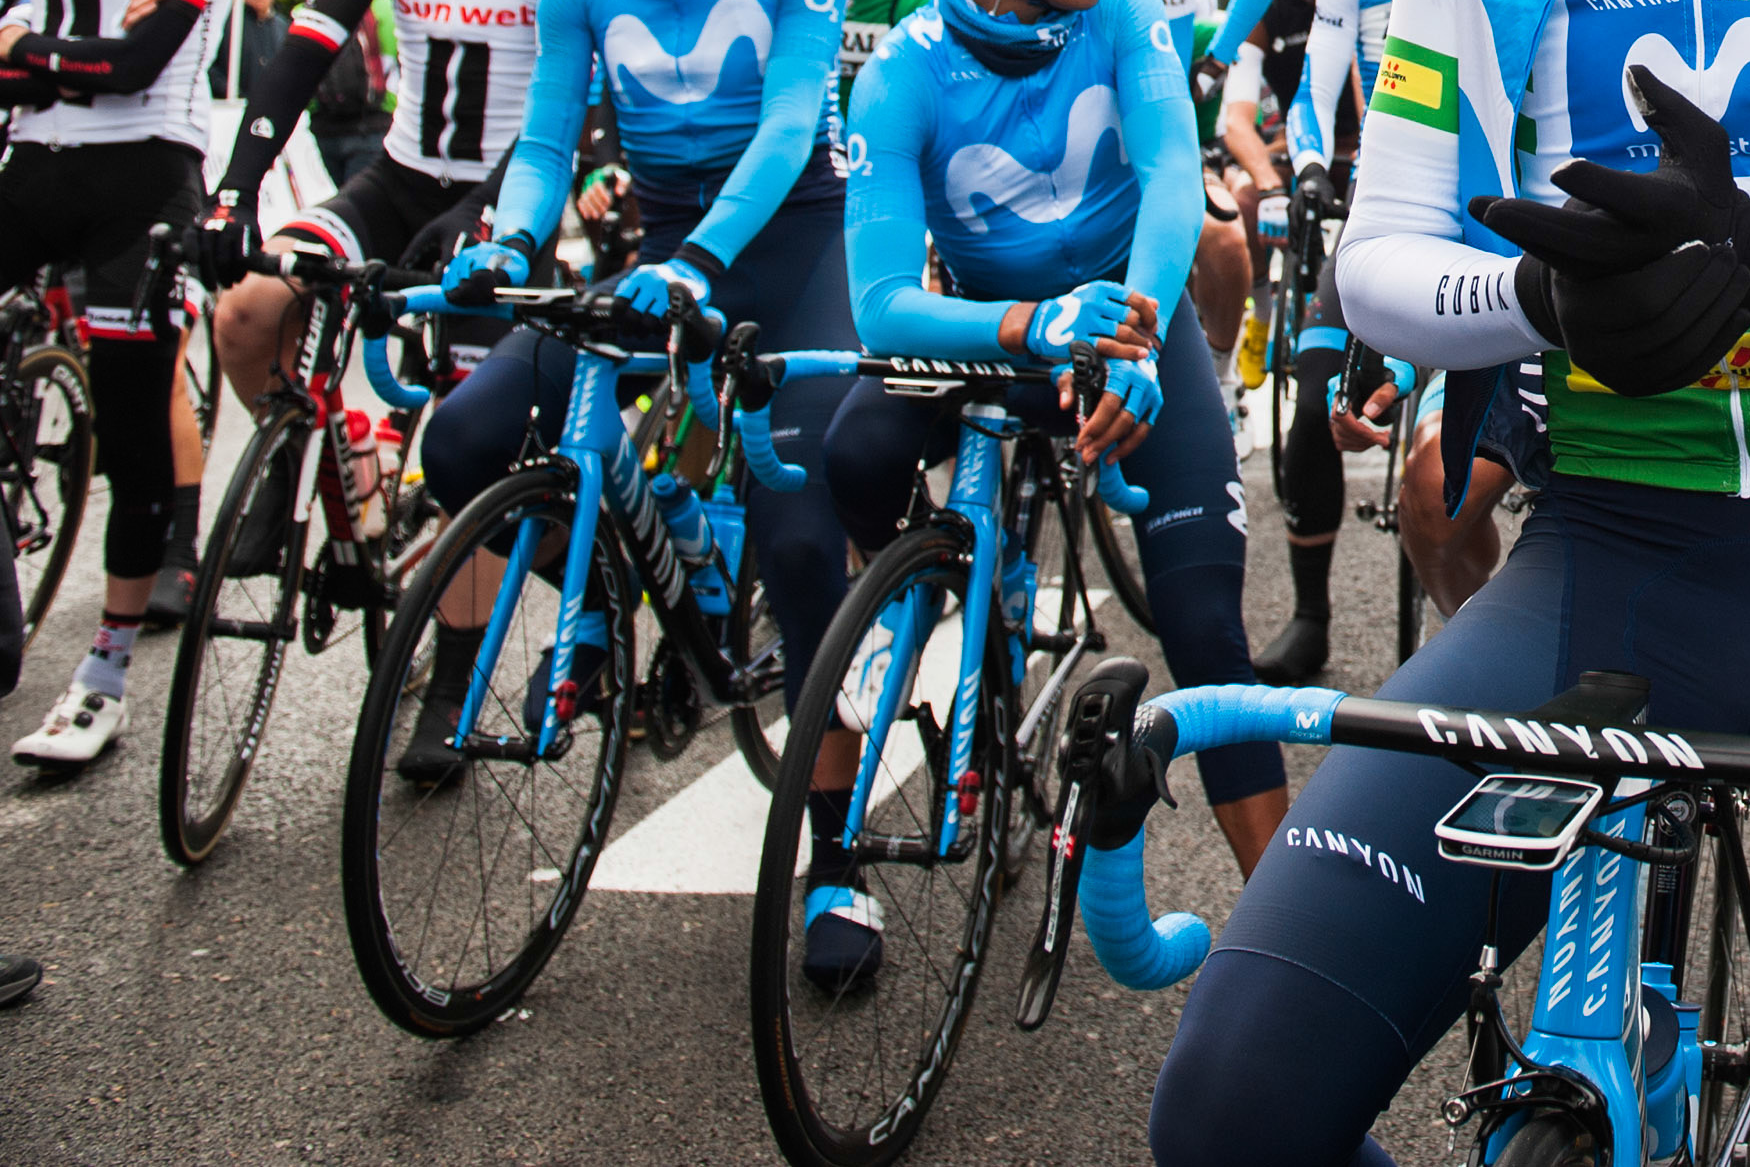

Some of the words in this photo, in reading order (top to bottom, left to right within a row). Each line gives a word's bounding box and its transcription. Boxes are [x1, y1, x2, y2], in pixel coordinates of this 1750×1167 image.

[1435, 272, 1509, 316] GOBIK
[890, 356, 1017, 377] CANYON
[1417, 709, 1705, 769] CANYON
[1287, 827, 1426, 904] CANYON
[1462, 844, 1524, 861] GARMIN
[1548, 847, 1586, 1013] ANYON
